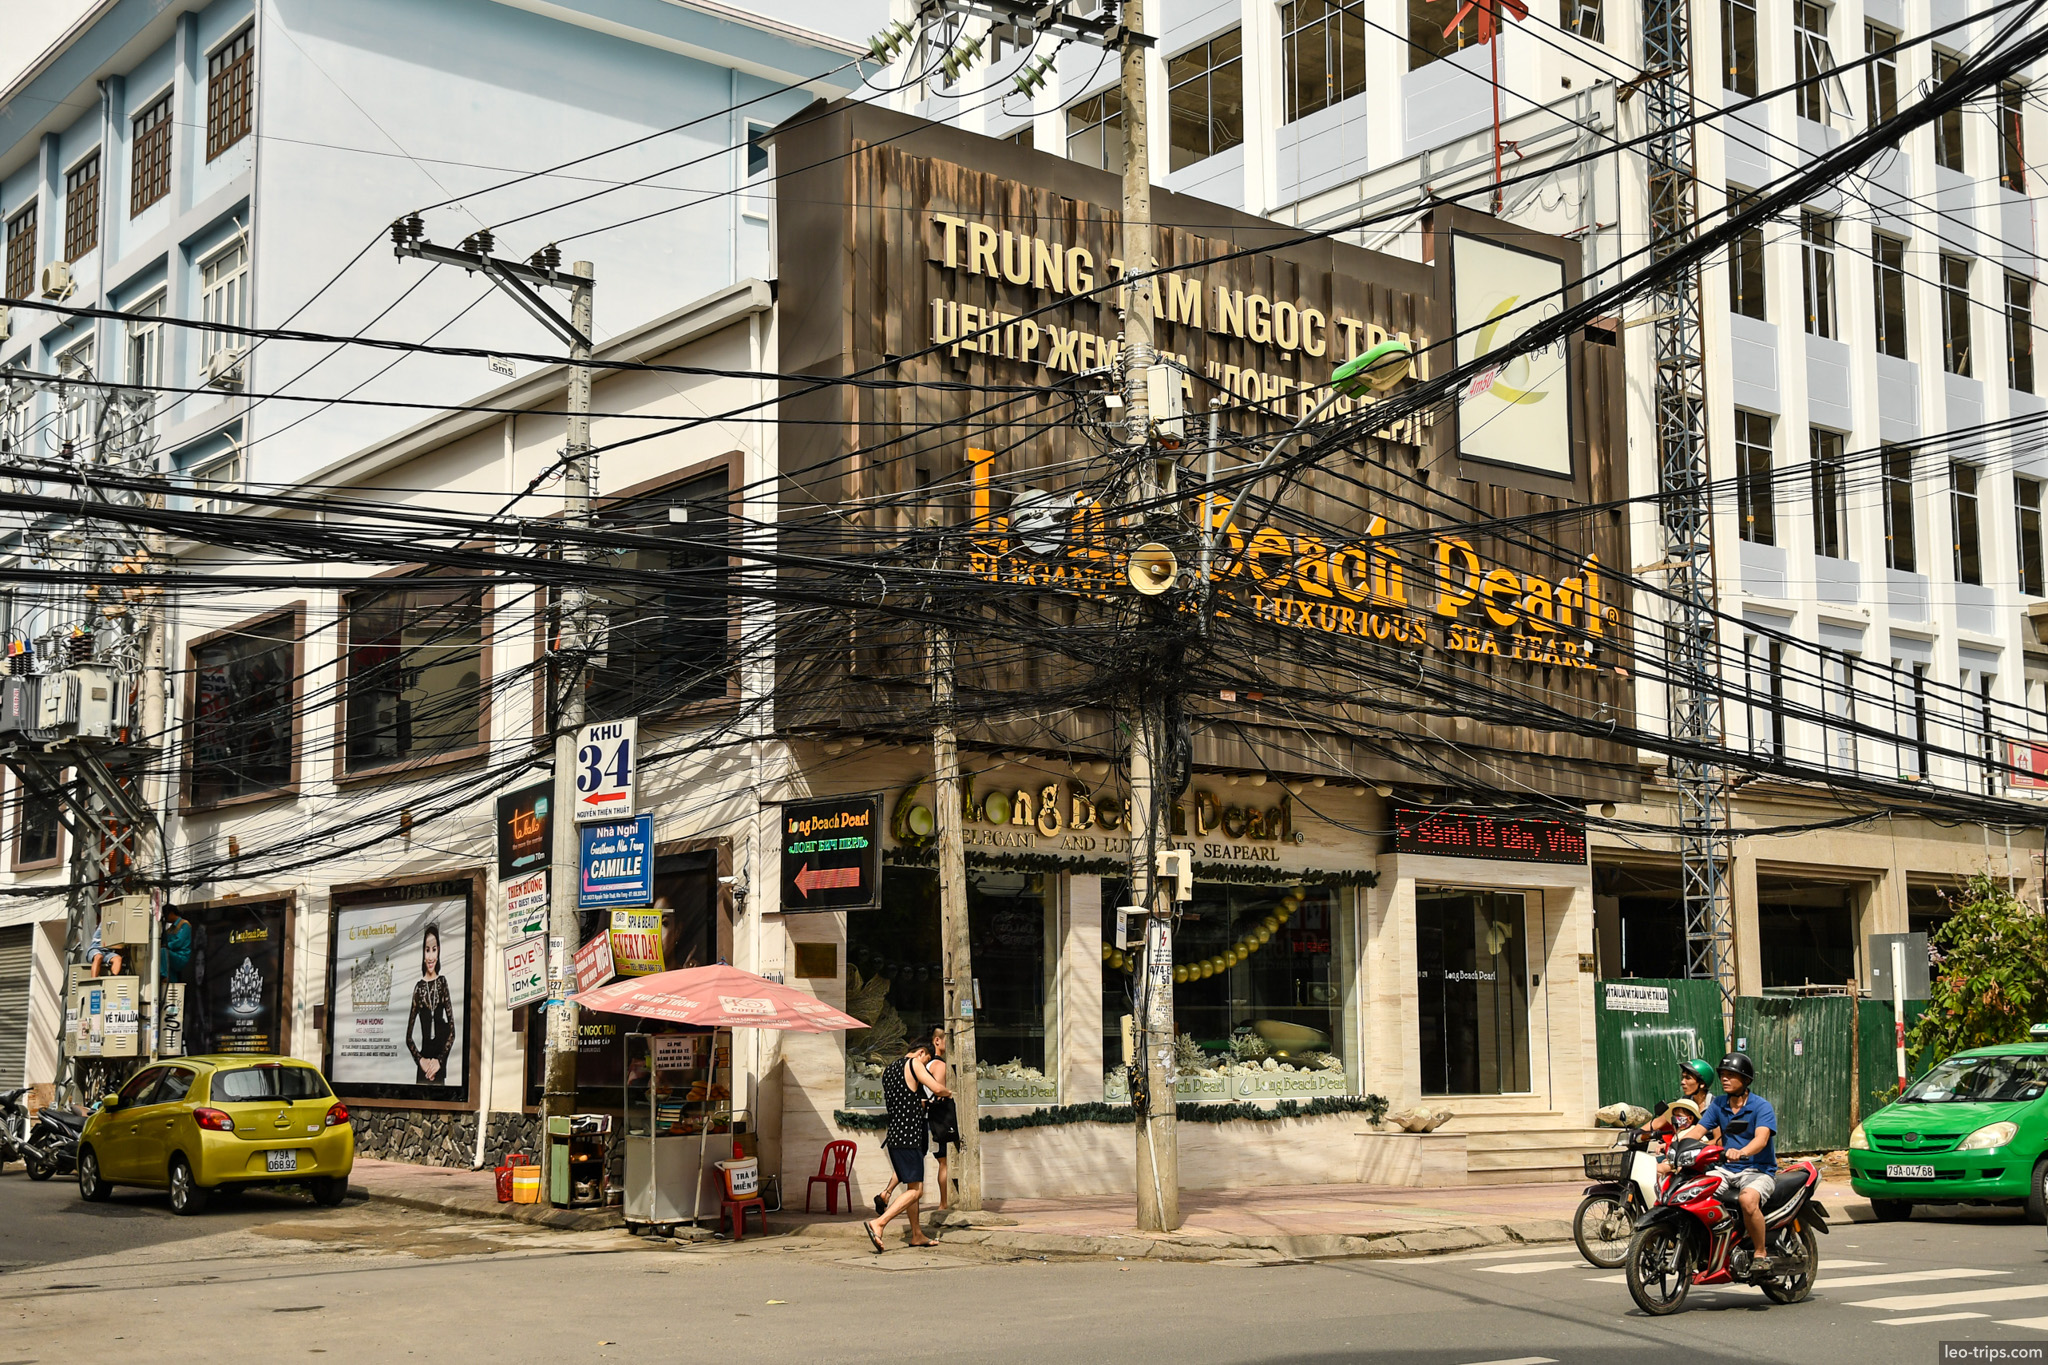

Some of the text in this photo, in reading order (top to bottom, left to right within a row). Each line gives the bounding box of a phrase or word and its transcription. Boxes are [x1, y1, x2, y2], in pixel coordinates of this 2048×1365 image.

[935, 213, 1094, 300] TRUNG
[1217, 285, 1326, 362] NGỌC
[933, 298, 1040, 363] ЦЕНТР
[493, 363, 513, 376] 5m5
[1470, 371, 1494, 396] 4m50
[1433, 532, 1604, 639] Pearl
[1251, 593, 1427, 644] LUXURIOUS
[1449, 623, 1500, 656] SEA
[590, 723, 623, 742] KHU
[577, 739, 632, 792] 34
[788, 809, 869, 837] Long Beach Pearl
[1195, 791, 1294, 843] Pearl
[596, 822, 639, 838] Nhà Nghỉ
[962, 829, 1039, 849] ELEGANT
[1060, 835, 1096, 851] AND
[1204, 843, 1280, 862] SEAPEARL
[590, 856, 643, 879] CAMILLE
[628, 915, 637, 928] SPA
[642, 915, 659, 929] BEAUTY
[613, 933, 659, 960] EVERY DAY
[508, 950, 535, 971] LOVE
[512, 967, 533, 979] HOTEL
[1444, 970, 1496, 983] Long Beach Pearl
[512, 979, 530, 993] 10M
[105, 1012, 113, 1023] VÉ
[114, 1011, 127, 1022] TÀU
[584, 1025, 602, 1038] NGỌC
[603, 1024, 617, 1035] TRAI
[1193, 1077, 1226, 1093] Pearl
[1255, 1073, 1349, 1095] Long Beach Pearl
[855, 1086, 883, 1104] Long
[977, 1083, 1058, 1104] ong Beach Pearl
[274, 1150, 290, 1160] 79A
[268, 1160, 296, 1171] 068.92
[1888, 1166, 1933, 1177] 79A-047.68
[736, 1171, 750, 1180] TRÀ
[734, 1181, 752, 1190] MIỄN
